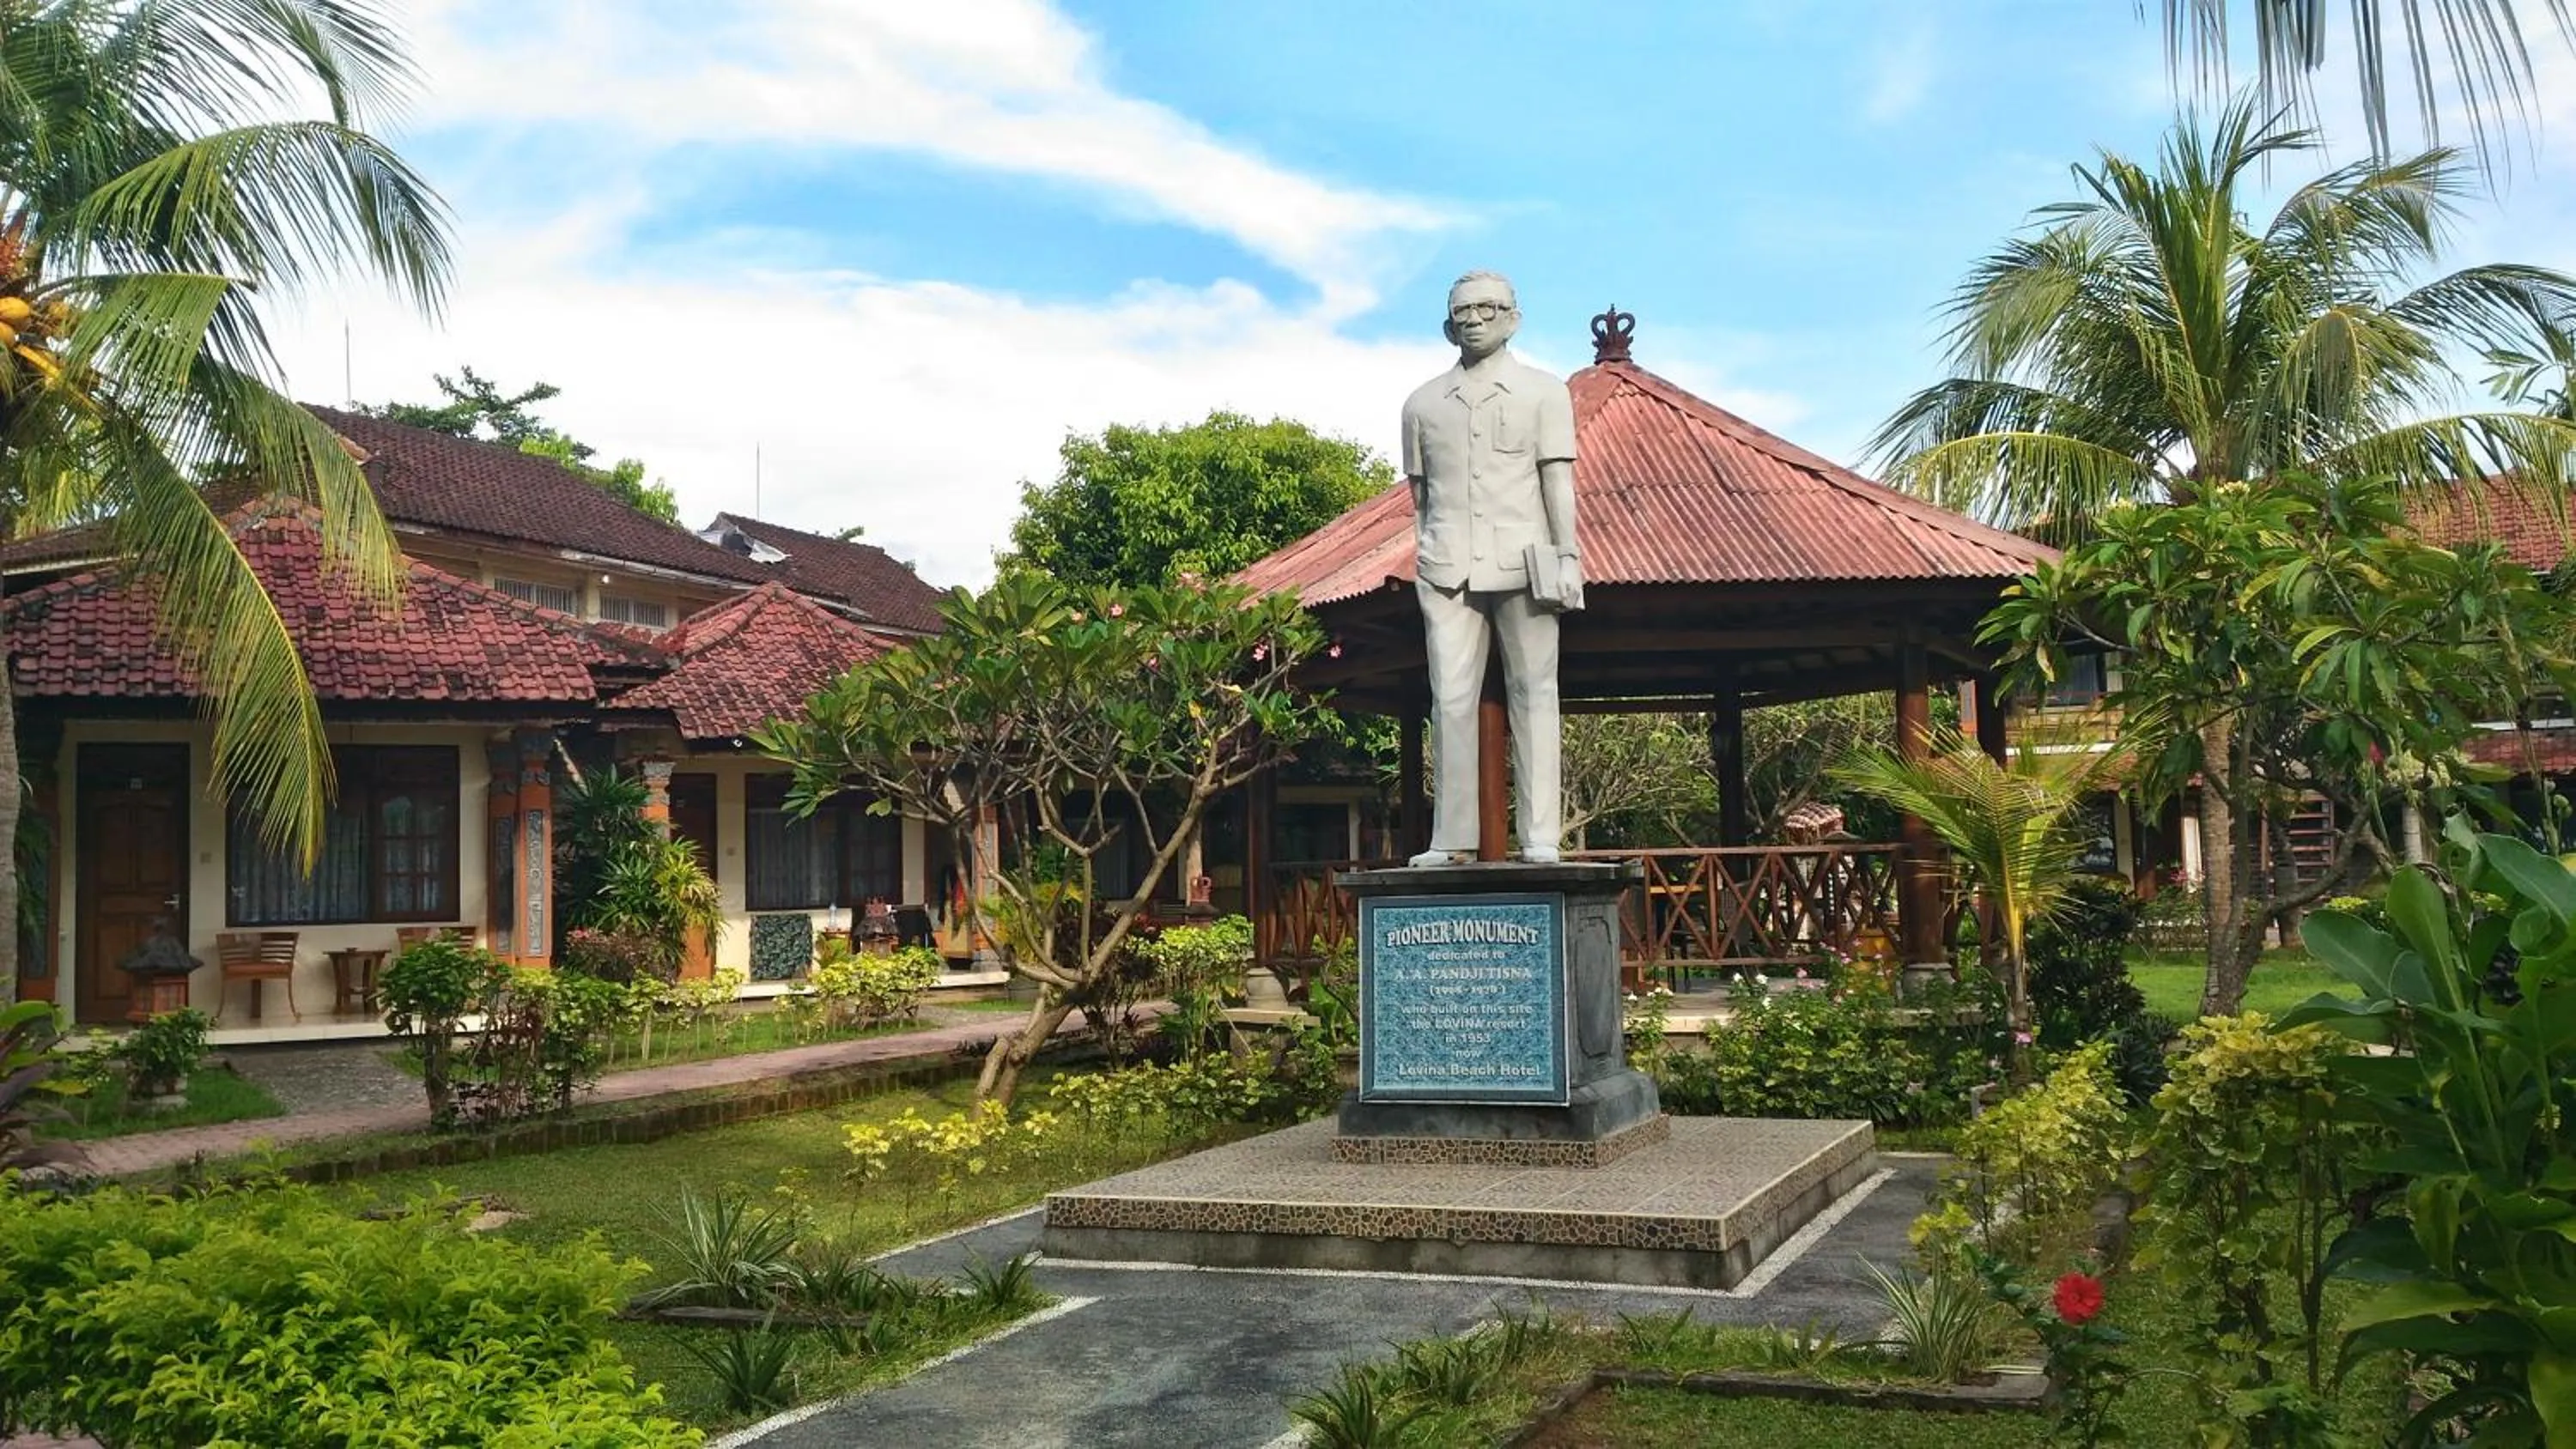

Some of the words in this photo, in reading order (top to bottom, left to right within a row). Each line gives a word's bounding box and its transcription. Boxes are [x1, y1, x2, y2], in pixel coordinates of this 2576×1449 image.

[1387, 921, 1451, 947] PIONEER
[1452, 919, 1540, 944] MONUMENT
[1426, 949, 1488, 961] dedicated
[1400, 1003, 1427, 1014] who
[1430, 1002, 1458, 1014] built
[1461, 1004, 1479, 1014] on
[1480, 1003, 1505, 1014] this
[1509, 1003, 1533, 1014] site
[1411, 1018, 1431, 1029] the
[1435, 1017, 1483, 1028] LOVINA
[1444, 1033, 1457, 1043] in
[1461, 1033, 1492, 1043] 1953
[1455, 1049, 1482, 1059] now
[1399, 1064, 1445, 1076] Lovina
[1450, 1062, 1496, 1076] Beach
[1500, 1064, 1540, 1076] Hotel
